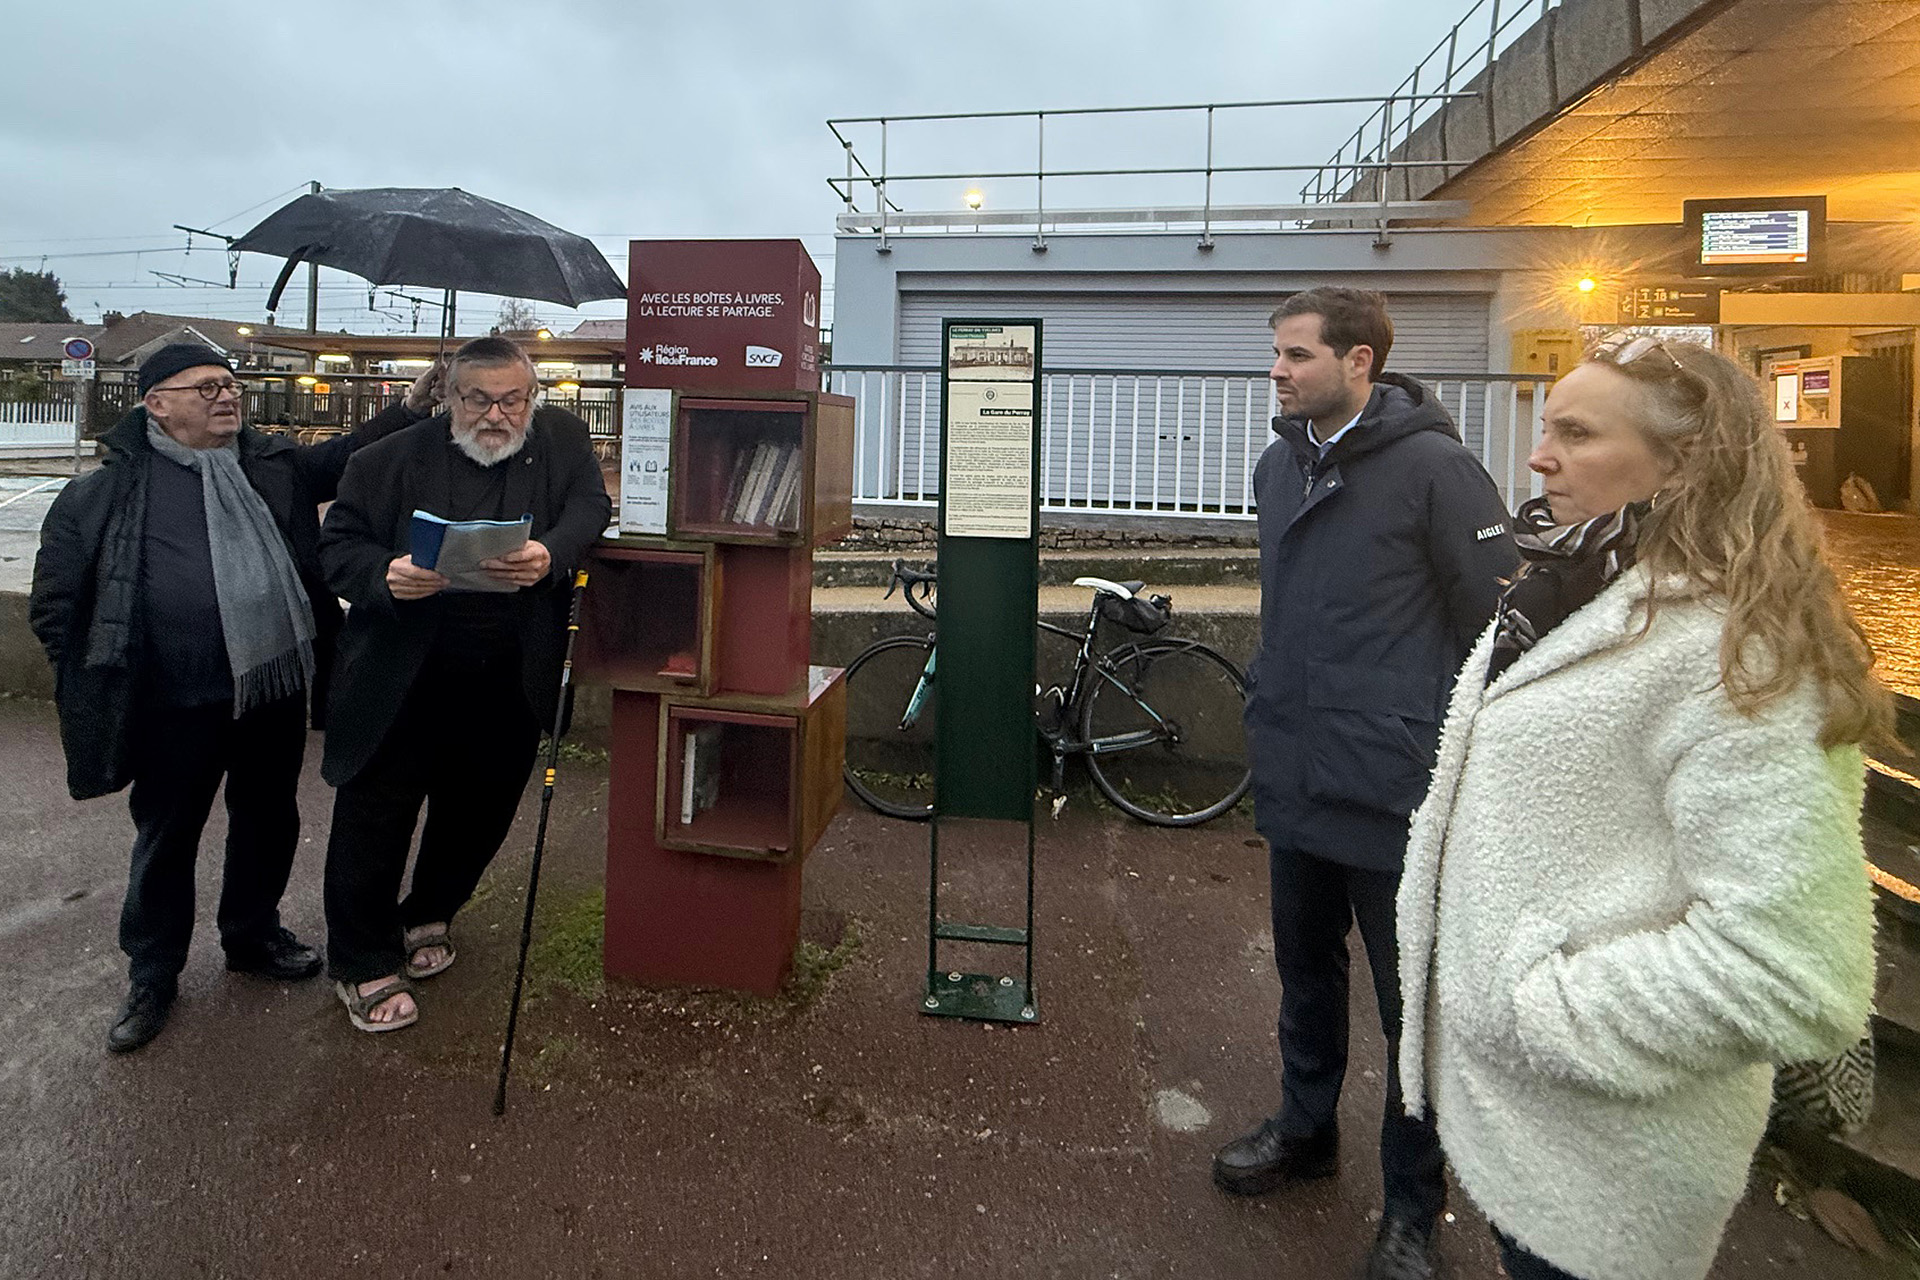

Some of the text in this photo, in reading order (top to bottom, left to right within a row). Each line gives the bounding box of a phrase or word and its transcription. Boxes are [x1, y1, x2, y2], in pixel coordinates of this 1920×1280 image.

[640, 291, 785, 305] AVEC LES BOÎTES À LIVRES,
[640, 306, 774, 317] LA LECTURE SE PARTAGE.
[655, 344, 689, 356] Région
[748, 354, 780, 364] SNCF
